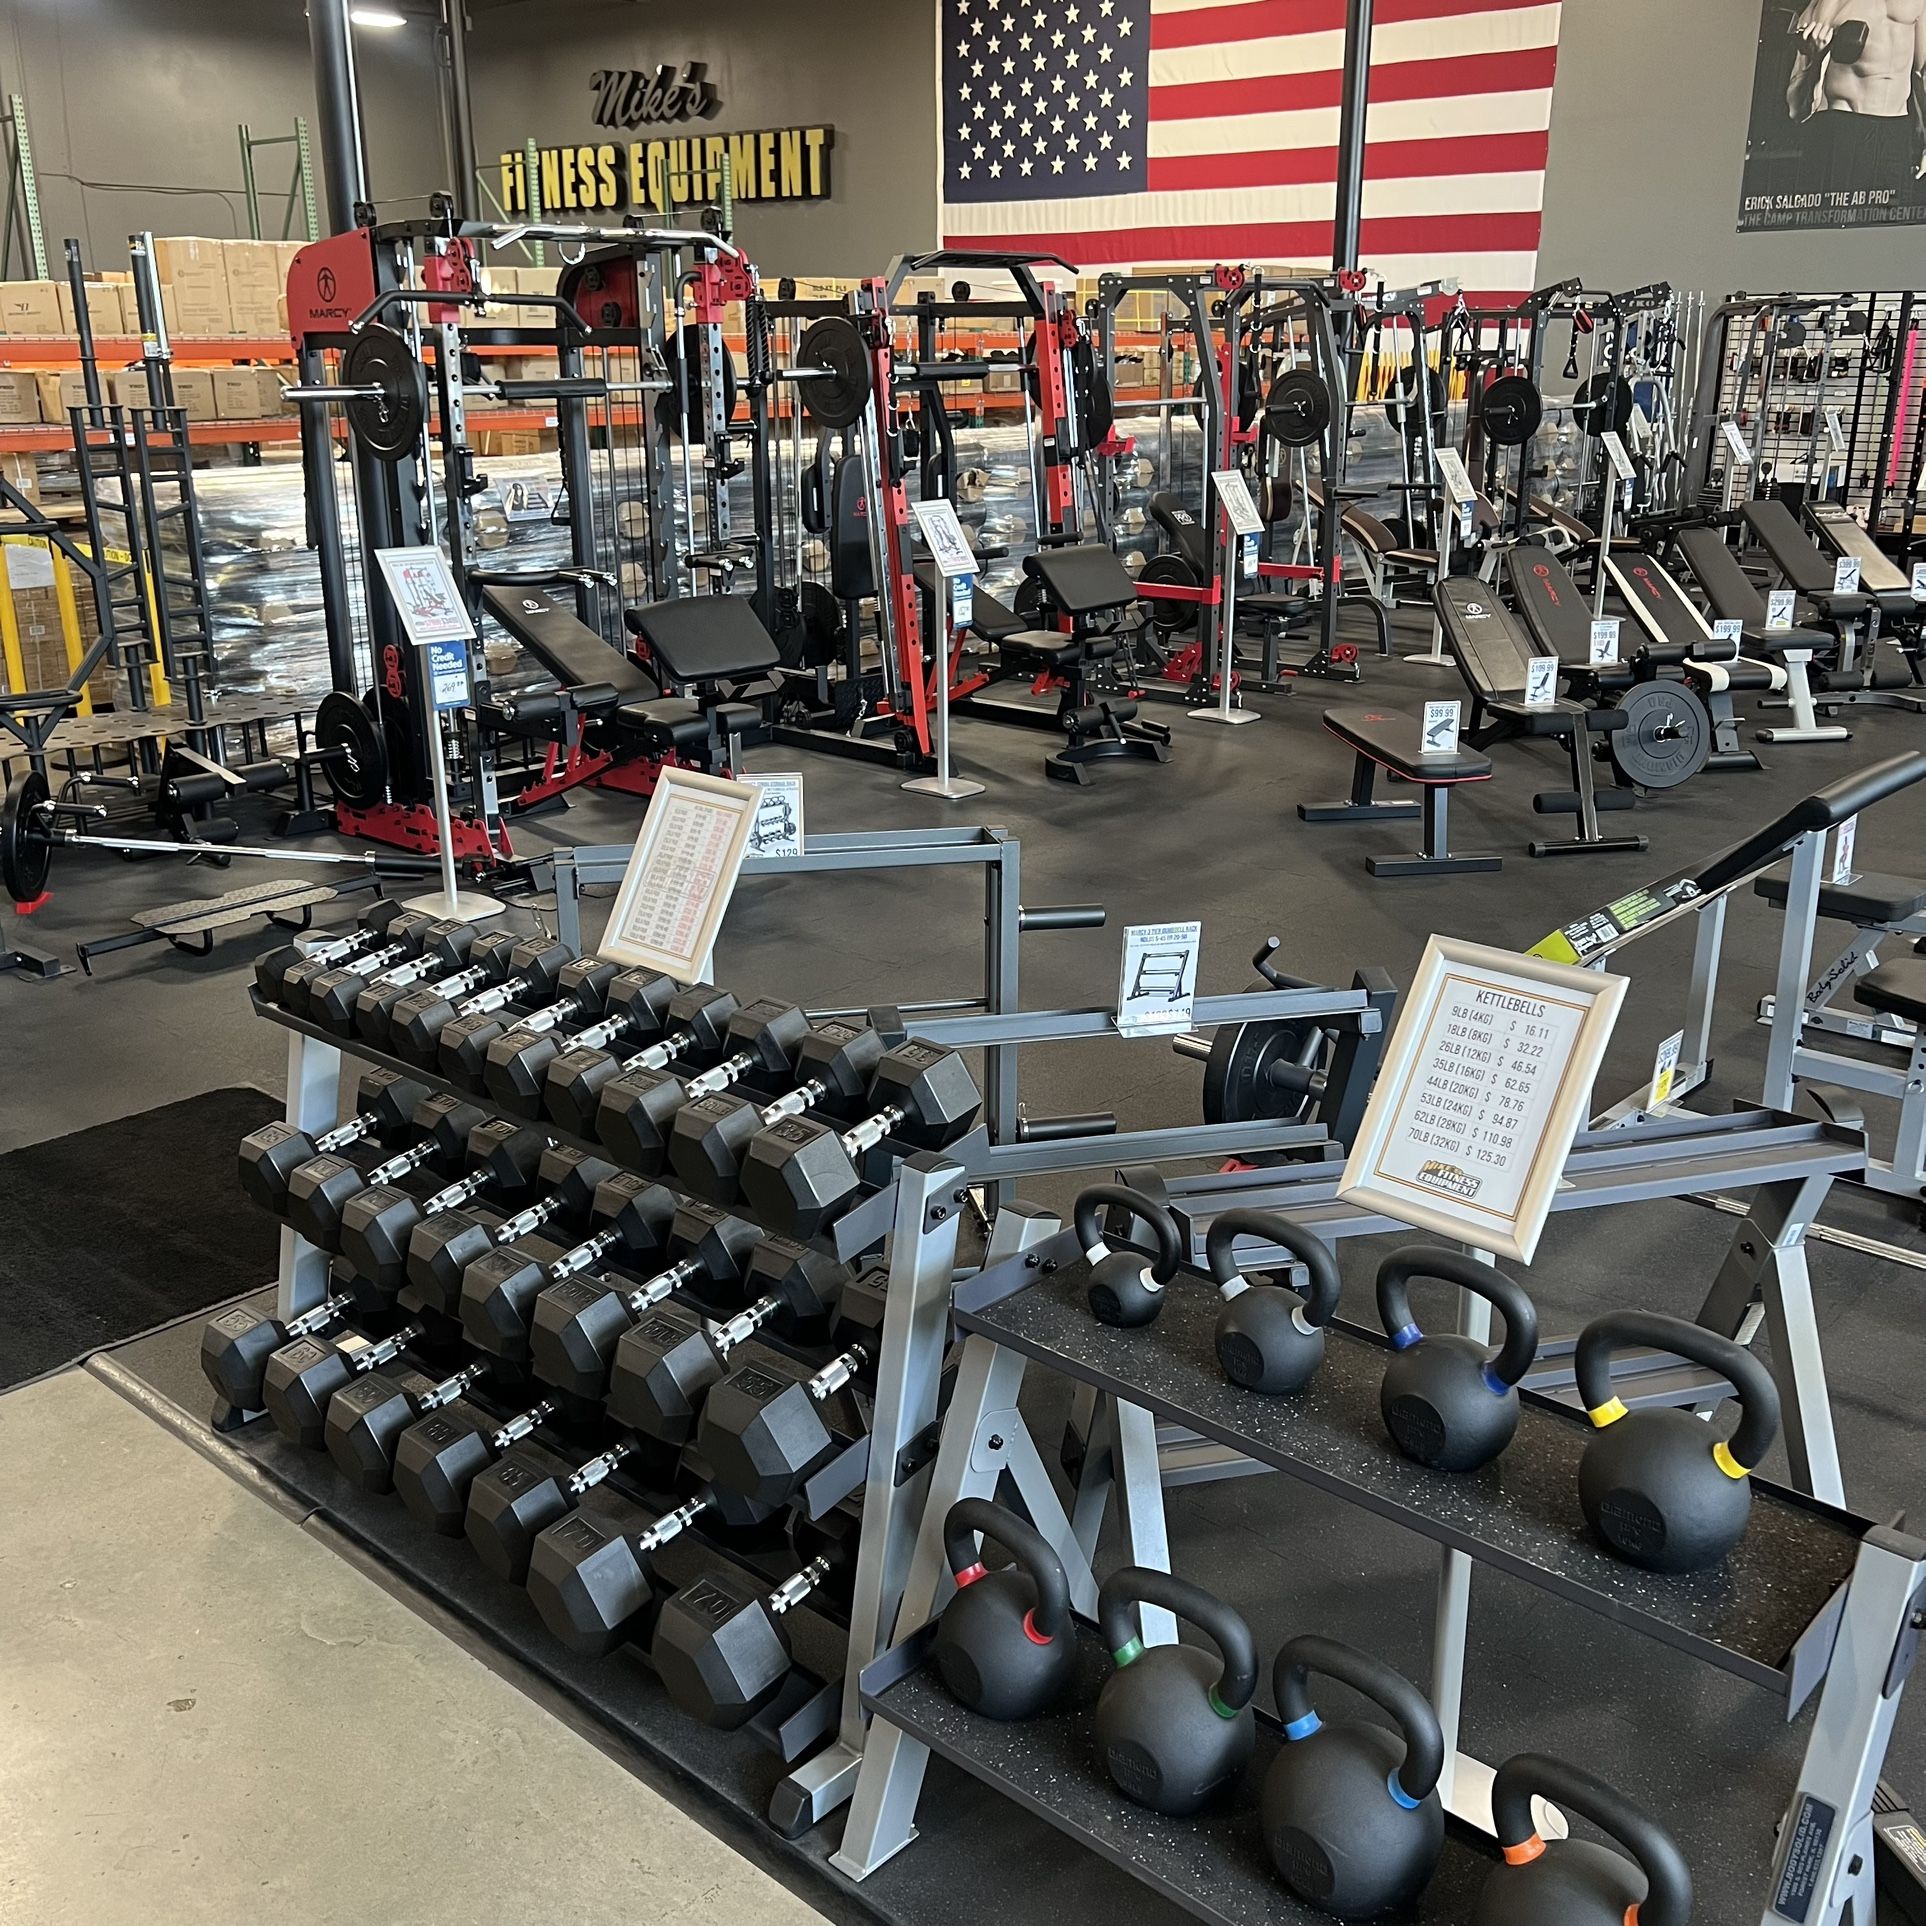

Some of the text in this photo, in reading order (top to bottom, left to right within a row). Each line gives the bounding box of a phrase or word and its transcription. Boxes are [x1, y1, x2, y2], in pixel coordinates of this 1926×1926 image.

[590, 62, 712, 127] Mike's
[500, 128, 825, 215] FINESS EQUIPMENT
[1744, 189, 1896, 210] ERICK SALGADO "THE AB PRO"
[1744, 205, 1926, 226] THE CAMP TRANSFORMATION CENTE
[309, 307, 349, 319] MARCY
[431, 646, 442, 654] No
[431, 653, 455, 663] Credit
[432, 660, 463, 671] Needed
[575, 960, 597, 970] 20
[1476, 990, 1546, 1018] KETTLEBELLS
[1451, 1005, 1468, 1020] 9LB
[1509, 1020, 1517, 1032] $
[1525, 1023, 1549, 1040] 16.11
[1447, 1024, 1467, 1038] 18LB
[1503, 1037, 1510, 1049] $
[1517, 1042, 1544, 1058] 32.22
[1439, 1041, 1461, 1055] 26LB
[1497, 1056, 1504, 1067] $
[1511, 1060, 1537, 1076] 46.54
[1433, 1058, 1455, 1073] 35LB
[1491, 1073, 1498, 1085] $
[1505, 1077, 1531, 1094] 62.65
[1426, 1076, 1448, 1089] 44LB
[1484, 1091, 1491, 1103] $
[1500, 1095, 1524, 1112] 78.76
[1420, 1092, 1442, 1108] 53LB
[1478, 1109, 1485, 1121] $
[1492, 1113, 1518, 1130] 94.87
[775, 1125, 812, 1142] 35
[1414, 1110, 1436, 1126] 62LB
[1472, 1127, 1479, 1138] $
[1482, 1130, 1513, 1149] 110.98
[1408, 1127, 1430, 1142] 70LB
[1465, 1145, 1472, 1156] $
[1476, 1149, 1506, 1167] 125.30
[1420, 1172, 1476, 1197] EQUIPMENT
[1438, 1170, 1480, 1188] FITNESS
[737, 1375, 773, 1398] 55
[563, 1523, 596, 1549] 70
[695, 1592, 731, 1616] 70
[1778, 1803, 1813, 1906] WWW.BODYSOLID.COM
